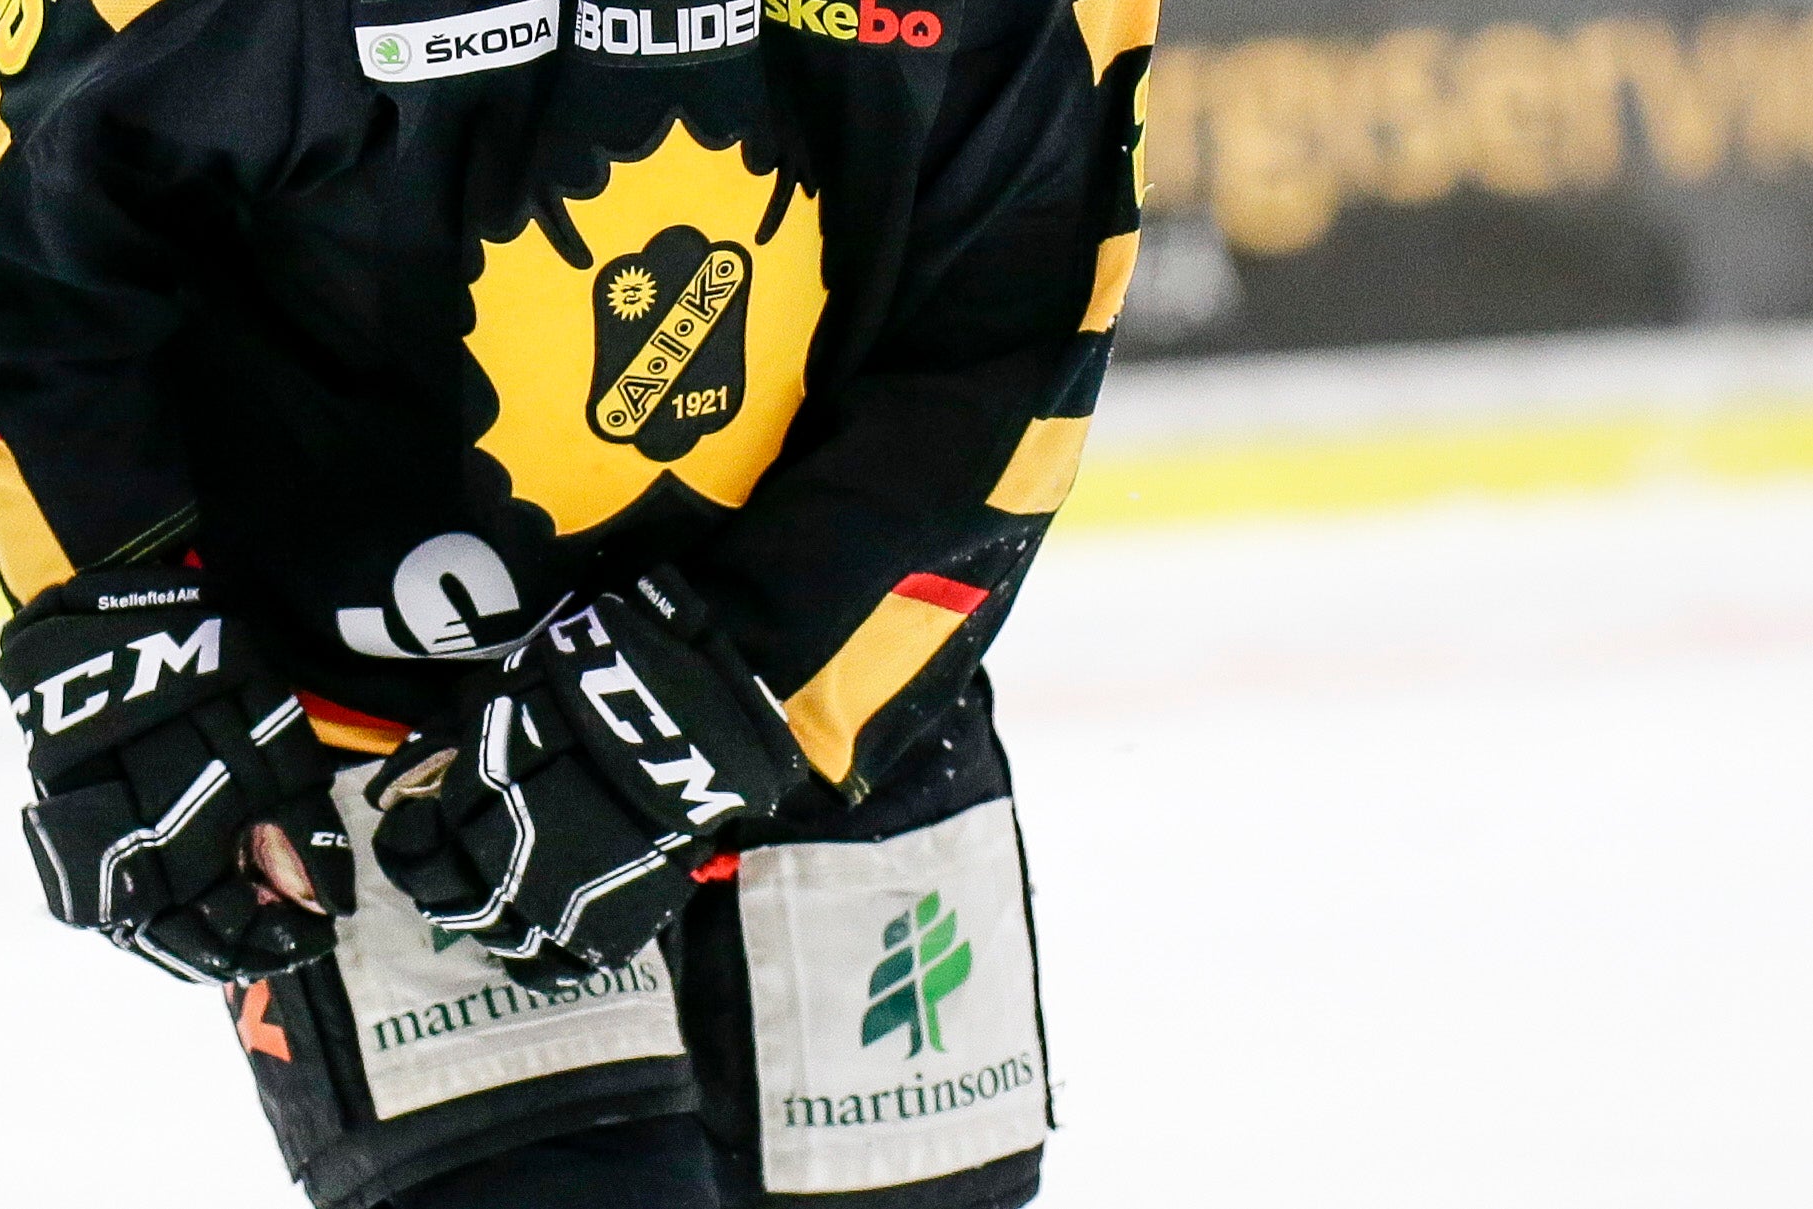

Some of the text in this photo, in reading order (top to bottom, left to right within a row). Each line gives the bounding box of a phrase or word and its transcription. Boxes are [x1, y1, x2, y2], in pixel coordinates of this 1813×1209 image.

[425, 17, 552, 64] ŠKODA
[671, 385, 729, 420] 1921
[548, 603, 746, 826] CCM
[781, 1051, 1034, 1128] martinsons
